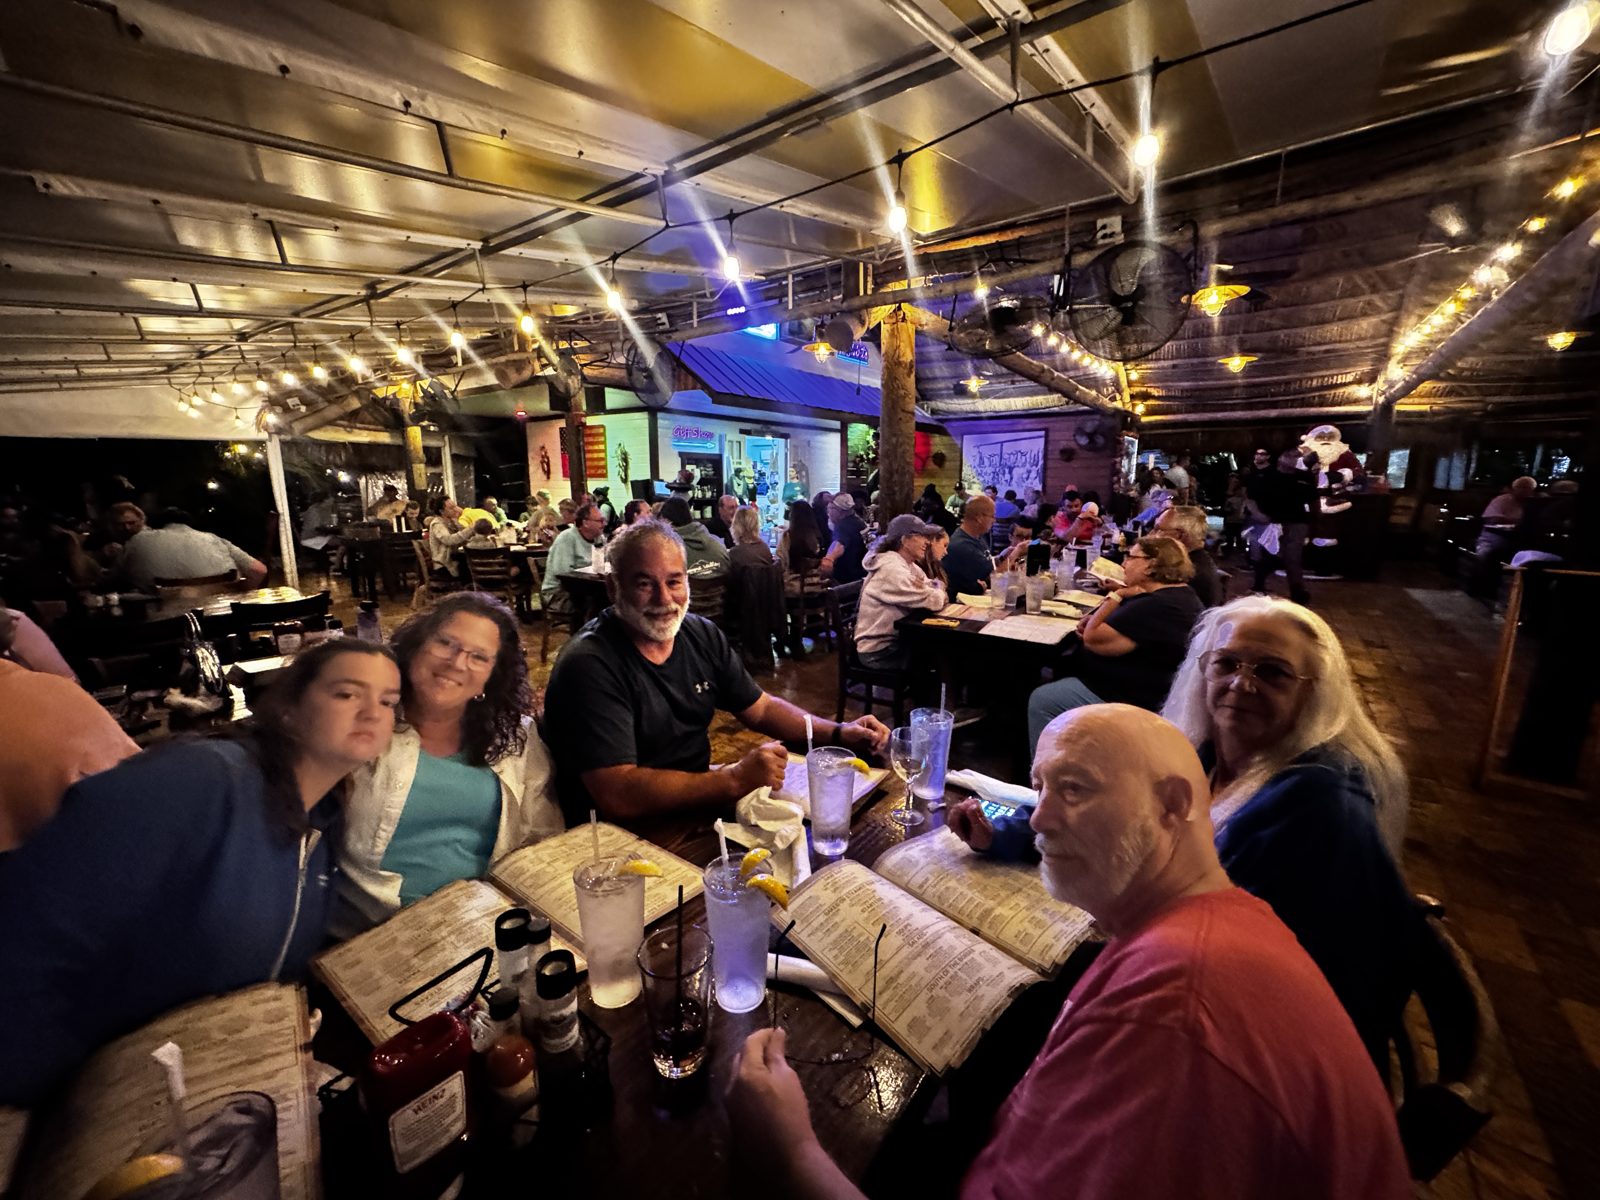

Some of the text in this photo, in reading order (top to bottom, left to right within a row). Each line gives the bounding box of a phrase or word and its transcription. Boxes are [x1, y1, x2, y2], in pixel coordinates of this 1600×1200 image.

[673, 425, 714, 440] Gift Shop
[926, 973, 944, 993] SOUTH
[941, 968, 950, 977] OF
[948, 959, 959, 970] THE
[412, 1088, 446, 1115] HEINZ
